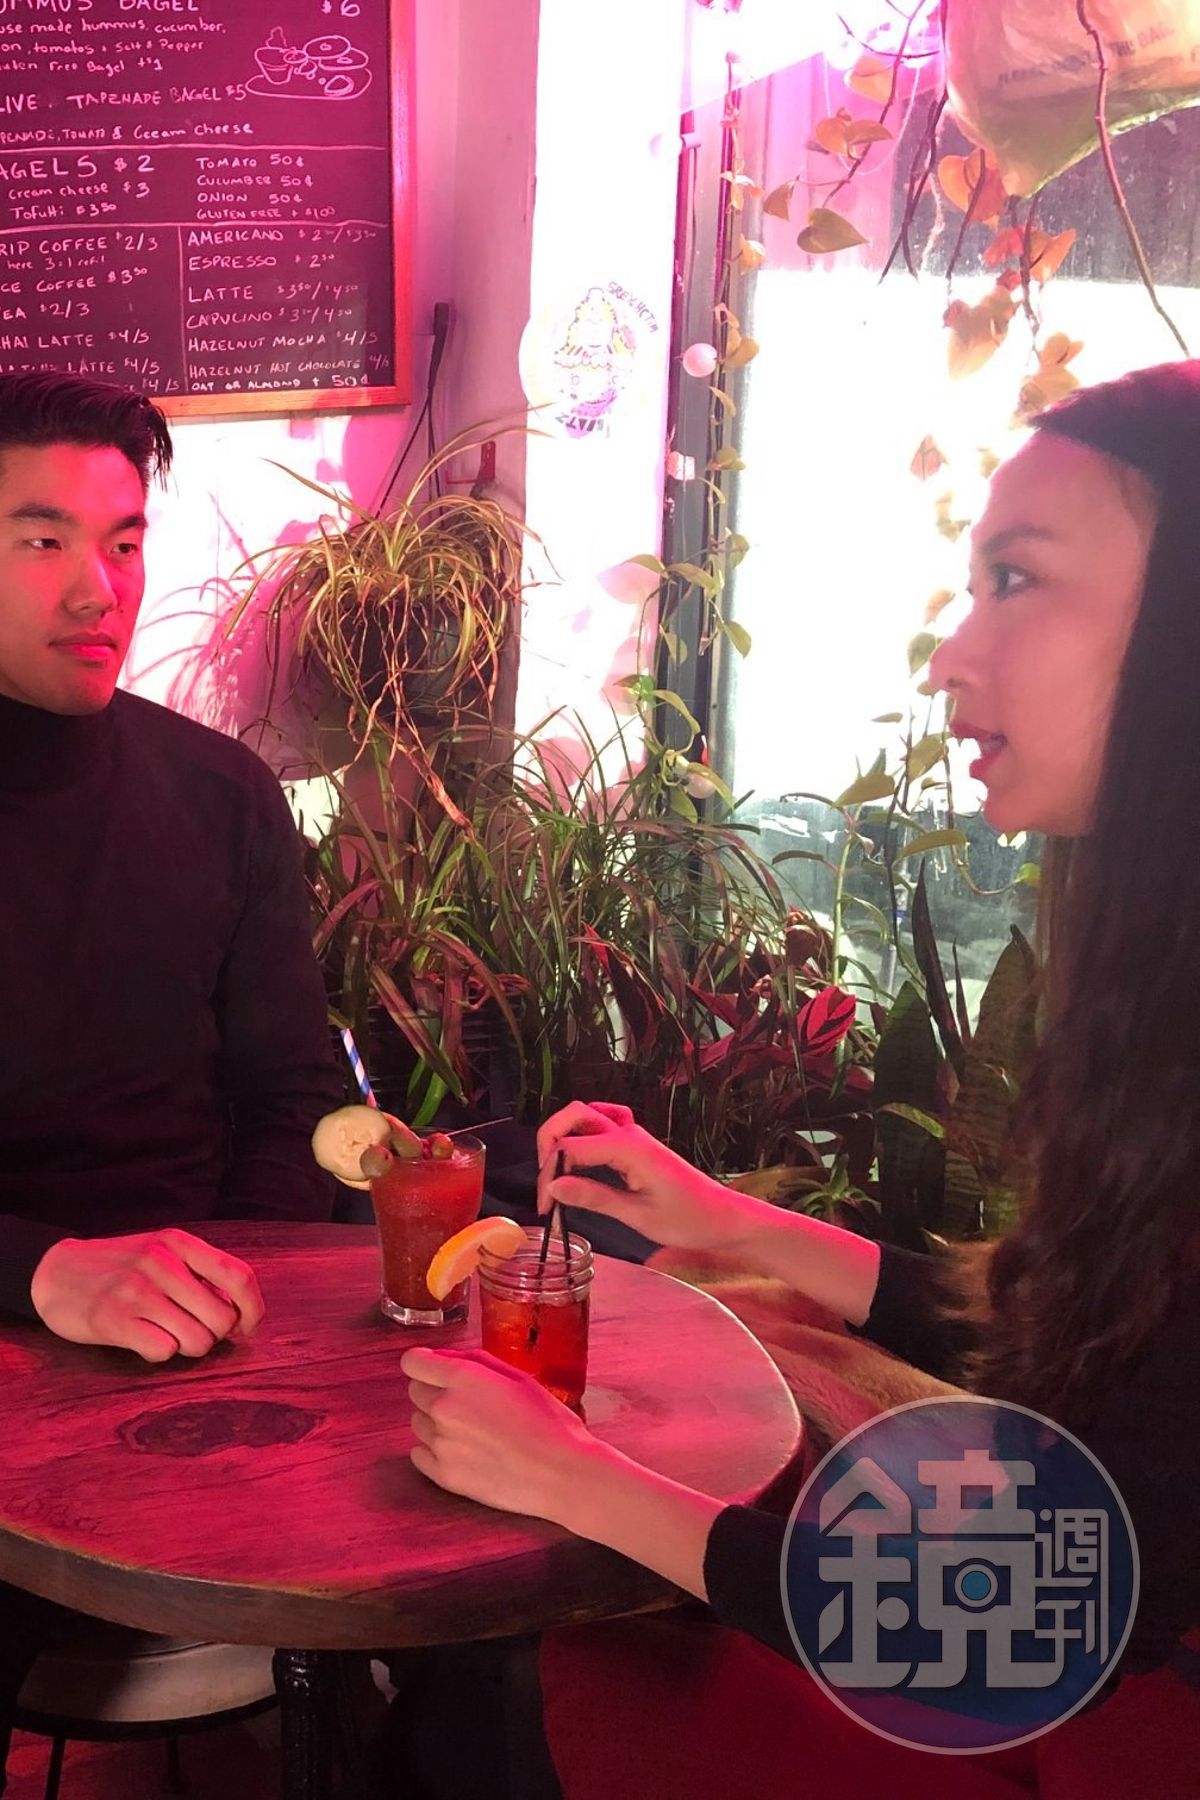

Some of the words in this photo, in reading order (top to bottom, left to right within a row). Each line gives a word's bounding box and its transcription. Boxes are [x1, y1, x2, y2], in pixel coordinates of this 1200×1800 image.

[30, 19, 72, 34] made
[169, 86, 222, 103] BAGEL
[195, 157, 257, 170] TOMATO
[59, 182, 110, 198] cheese
[197, 192, 248, 203] ONION
[38, 236, 108, 255] COFFEE
[187, 229, 284, 247] AMERICANO
[188, 255, 277, 271] ESPRESSO
[36, 276, 97, 293] COFFEE
[188, 285, 254, 304] LATTE
[186, 309, 273, 330] CAPUCINO
[37, 333, 95, 349] LATTE
[188, 336, 266, 352] HAZELNUT
[272, 333, 327, 348] MOCHA
[189, 362, 261, 379] HAZELNUT
[269, 361, 290, 374] HOT
[191, 381, 215, 392] OAT
